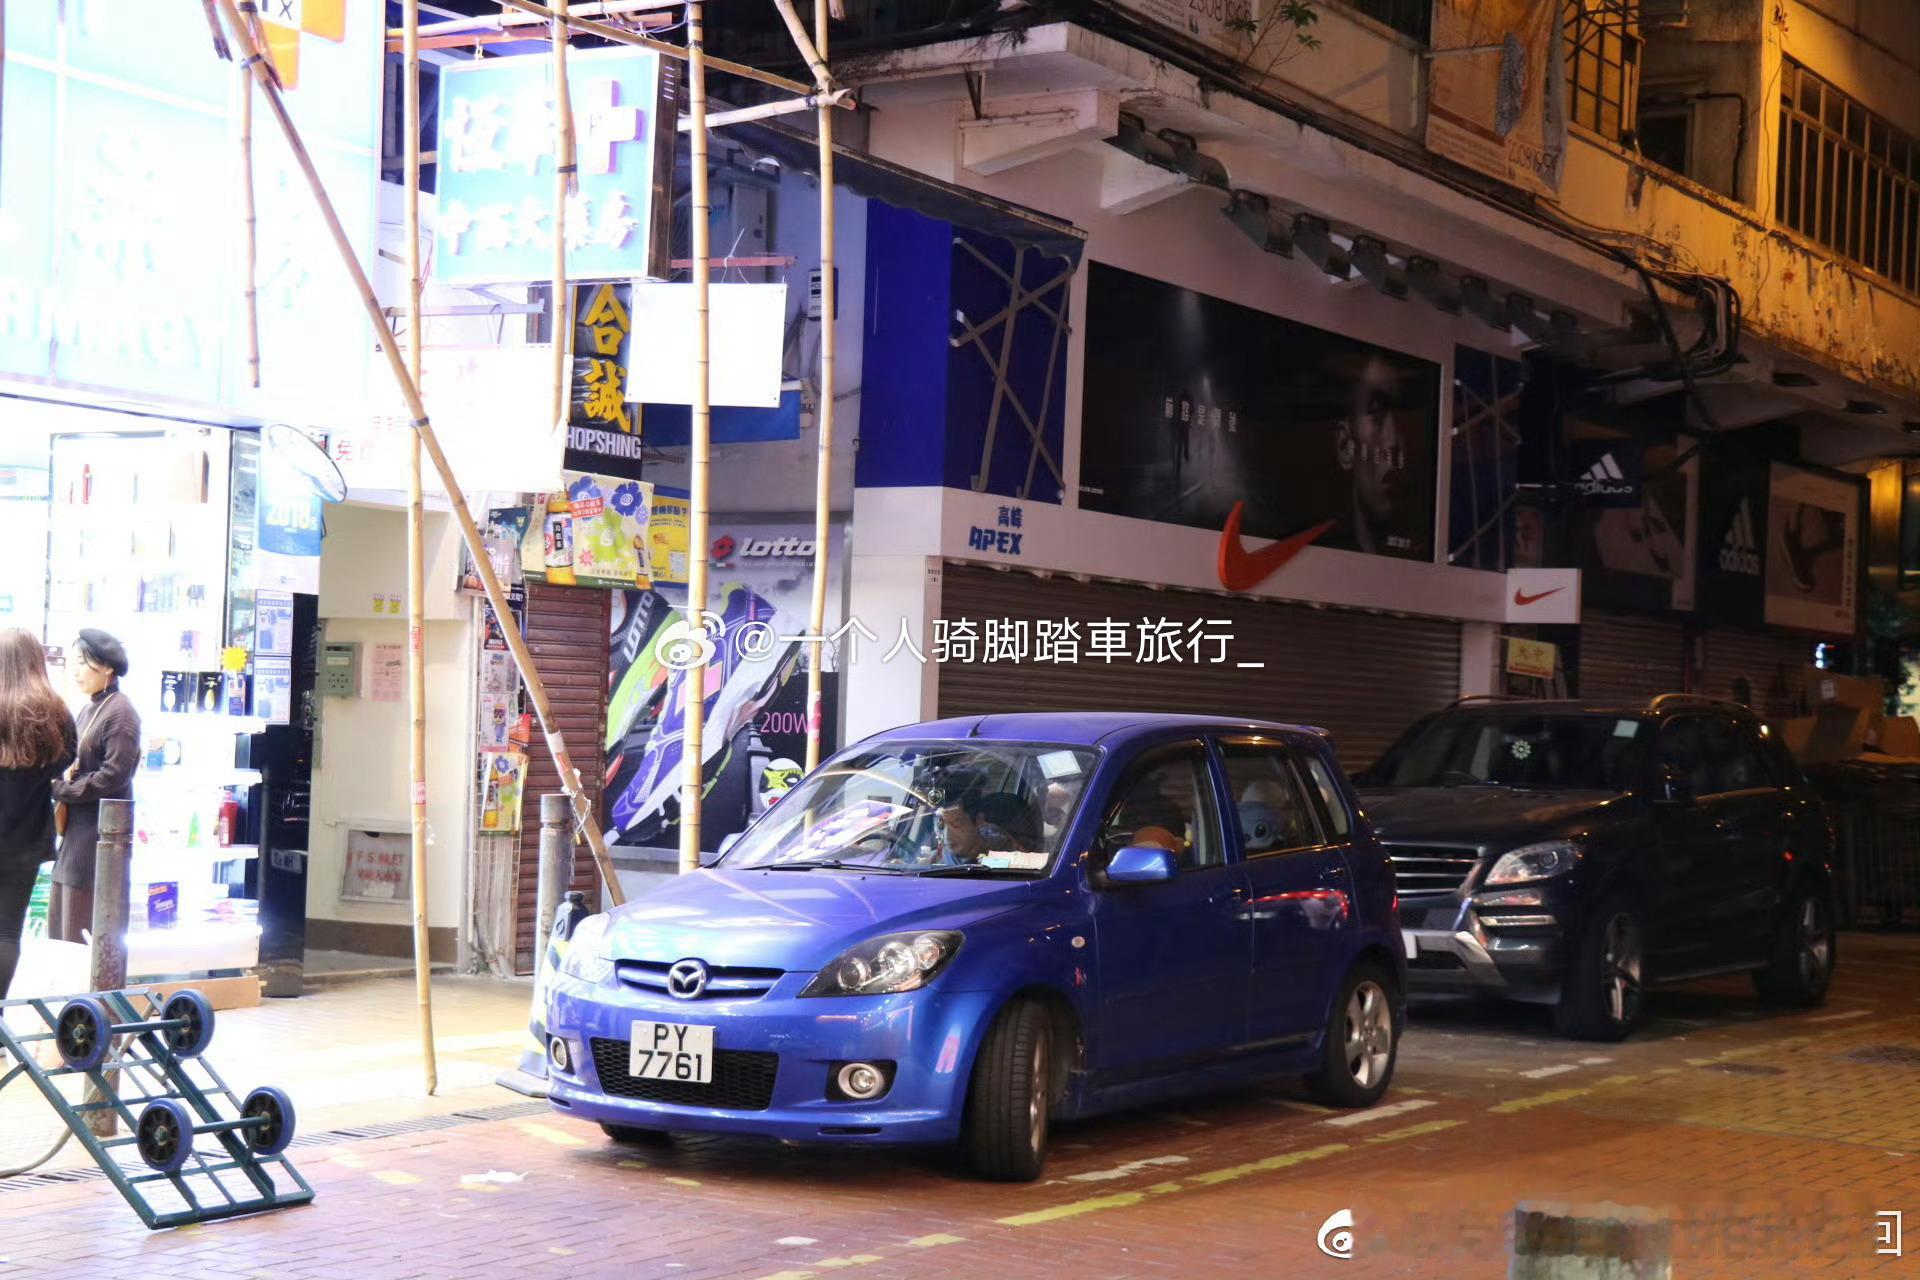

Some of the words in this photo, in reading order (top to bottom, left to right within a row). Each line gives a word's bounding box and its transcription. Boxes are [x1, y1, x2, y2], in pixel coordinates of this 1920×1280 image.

[968, 525, 1024, 556] APEX
[1719, 546, 1760, 576] adidas
[654, 1023, 688, 1051] PY
[638, 1050, 702, 1080] 7761
